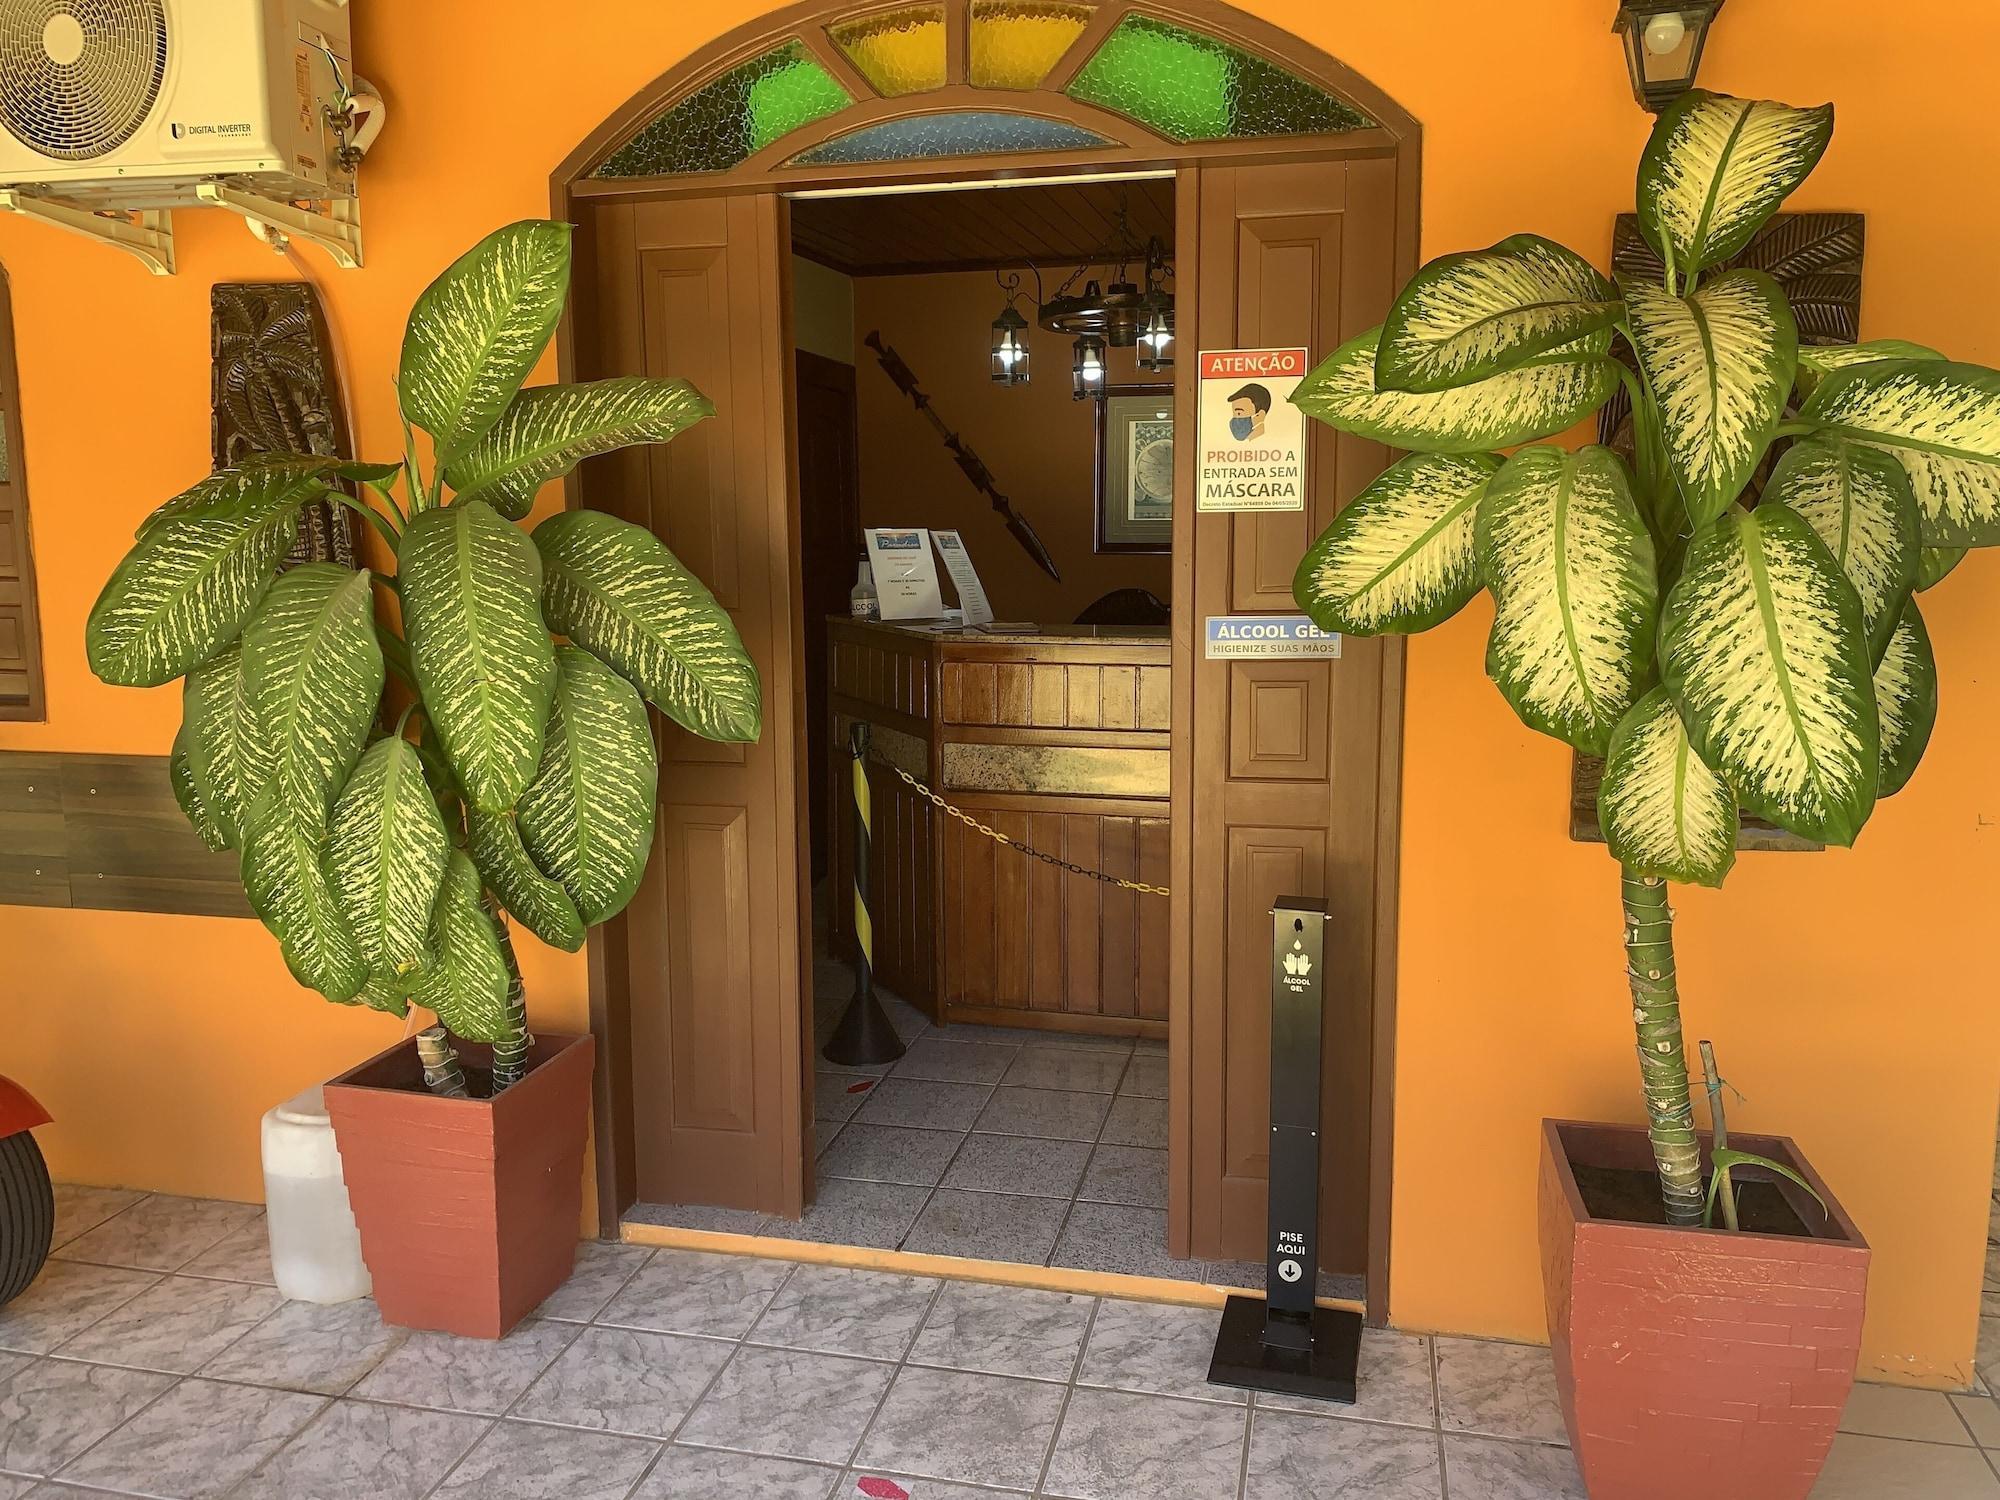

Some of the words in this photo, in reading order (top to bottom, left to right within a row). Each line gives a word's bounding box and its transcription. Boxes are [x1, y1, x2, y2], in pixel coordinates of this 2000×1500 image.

[189, 126, 216, 134] DIGITAL
[217, 124, 251, 133] INVERTER
[1211, 353, 1295, 375] ATENÇÃO
[1207, 450, 1282, 463] PROIBIDO
[1285, 450, 1296, 462] A
[1203, 467, 1266, 479] ENTRADA
[1269, 466, 1298, 478] SEM
[1206, 480, 1296, 498] MÁSCARA
[1217, 622, 1290, 639] ÁLCOOL
[1213, 644, 1267, 653] HIGIENIZE
[1270, 644, 1299, 653] SUAS
[1302, 642, 1335, 653] MÃOS
[1283, 975, 1311, 985] ÁLCOOL
[1280, 1231, 1304, 1243] PISE
[1276, 1243, 1306, 1256] AQUI
